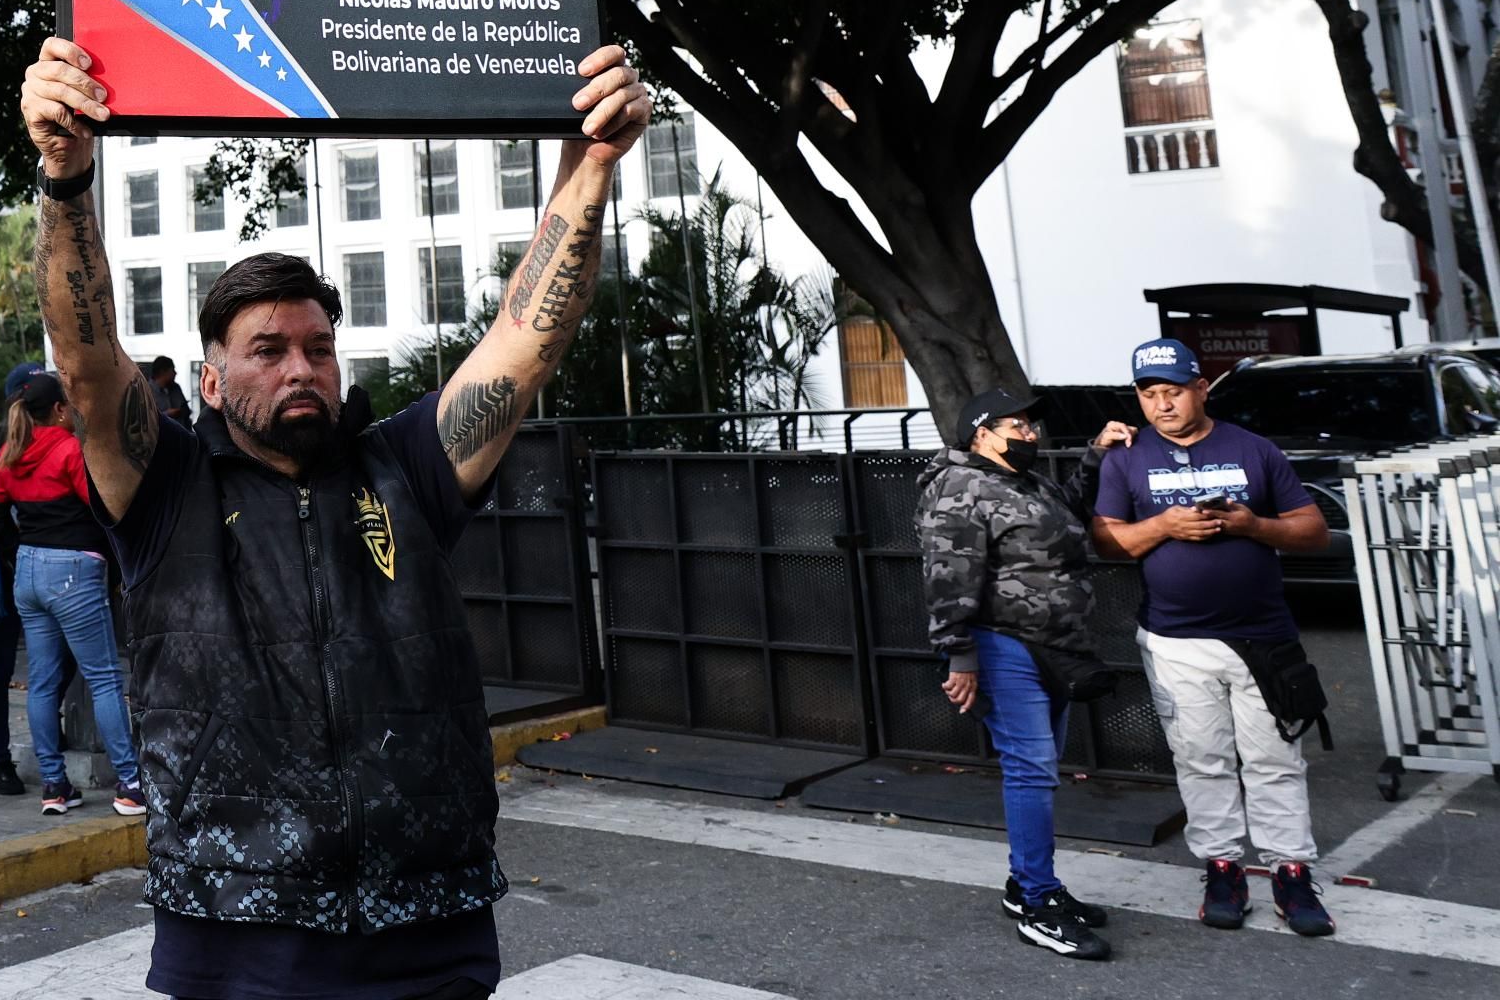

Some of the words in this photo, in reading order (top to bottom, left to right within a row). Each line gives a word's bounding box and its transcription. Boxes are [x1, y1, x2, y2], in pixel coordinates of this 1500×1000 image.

[321, 17, 427, 42] Presidente
[431, 20, 457, 42] de
[461, 20, 479, 42] la
[483, 19, 581, 47] República
[331, 49, 441, 75] Bolivariana
[445, 52, 471, 75] de
[474, 53, 577, 76] Venezuela
[1201, 339, 1269, 353] GRANDE
[1152, 496, 1188, 505] HUG
